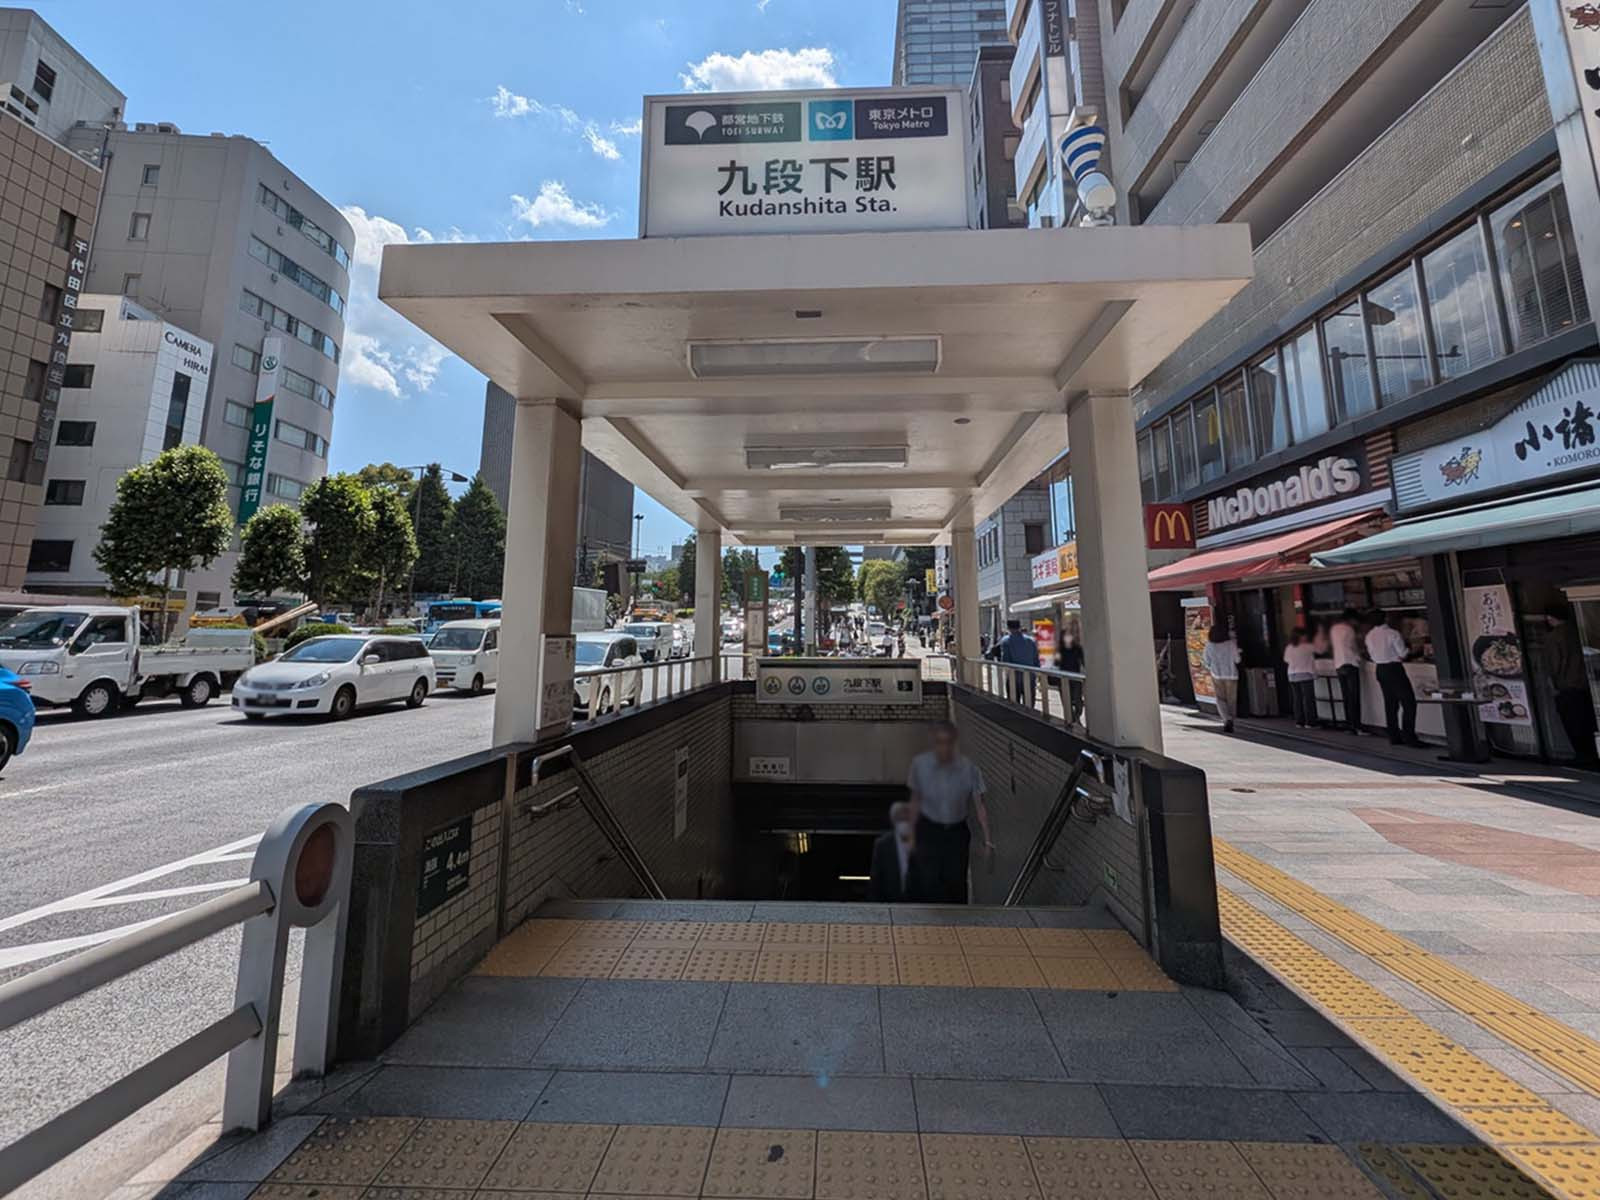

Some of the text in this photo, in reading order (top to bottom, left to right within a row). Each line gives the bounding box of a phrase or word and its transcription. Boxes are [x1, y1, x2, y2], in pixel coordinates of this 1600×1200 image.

[721, 113, 785, 126] 都営地下鉄
[868, 106, 934, 120] 東京メトロ
[745, 126, 784, 136] SUBWAY
[872, 120, 930, 130] Tokyo Metro
[717, 155, 896, 196] 九段下駅
[719, 196, 897, 217] Kudanshita Sta.
[164, 331, 202, 357] CAMERA
[1514, 400, 1600, 461] 小諸
[244, 423, 267, 502] りそな銀行
[1207, 455, 1361, 531] McDonald's
